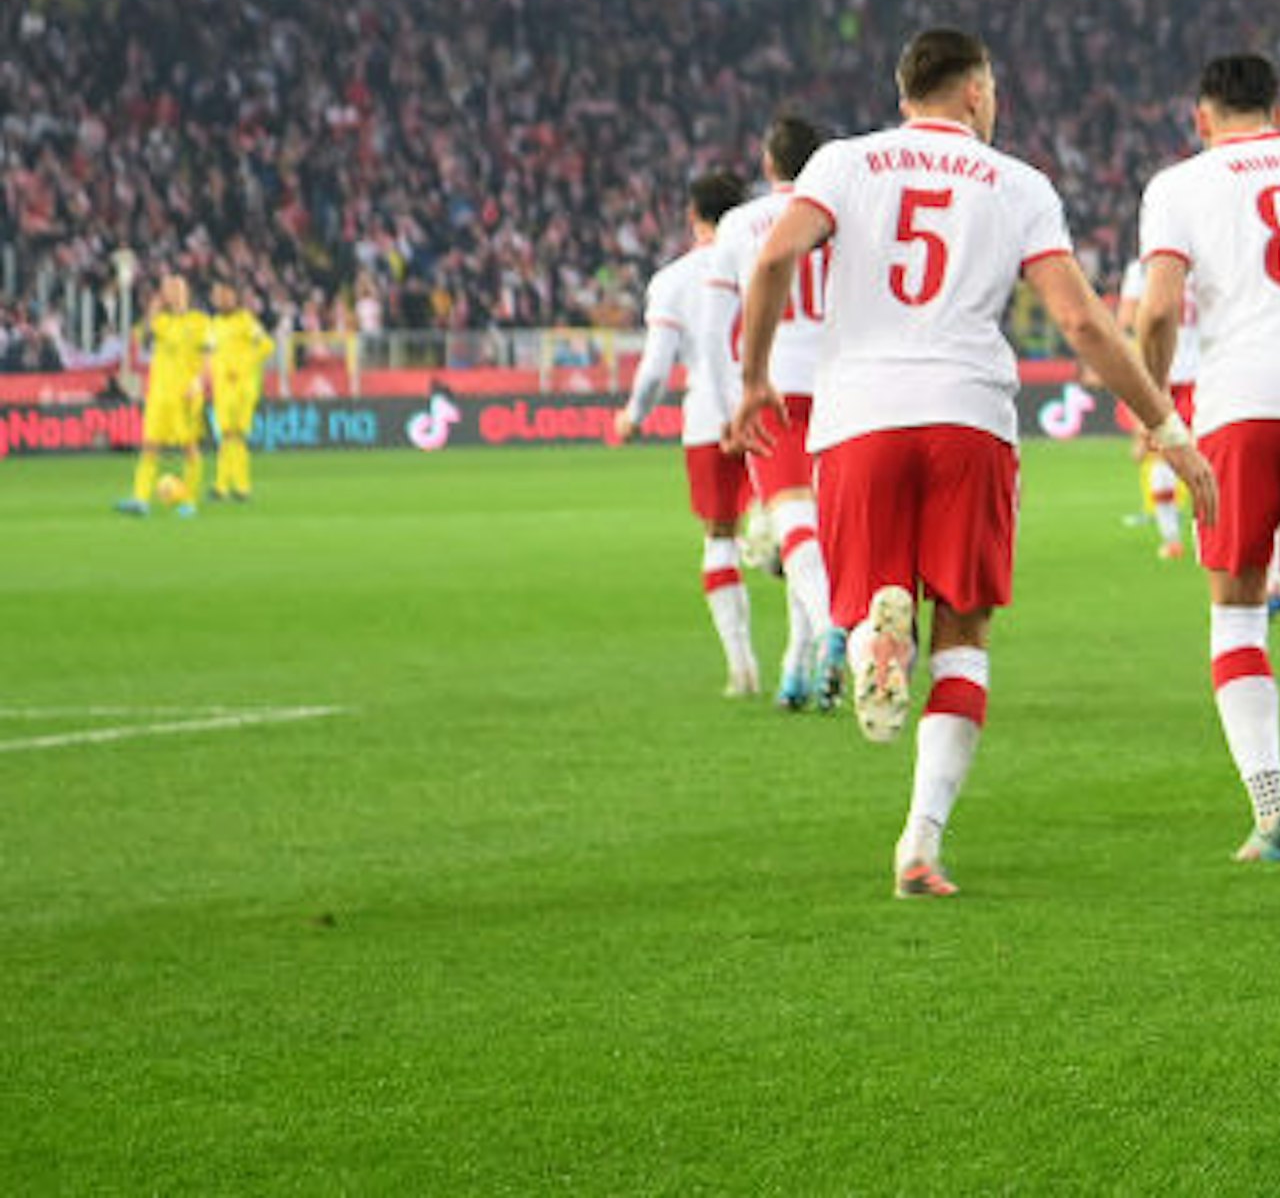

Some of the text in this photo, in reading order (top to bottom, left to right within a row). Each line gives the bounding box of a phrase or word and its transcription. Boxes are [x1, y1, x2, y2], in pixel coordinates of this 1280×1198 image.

[780, 240, 833, 323] 0
[889, 187, 953, 307] 5
[328, 410, 376, 442] na
